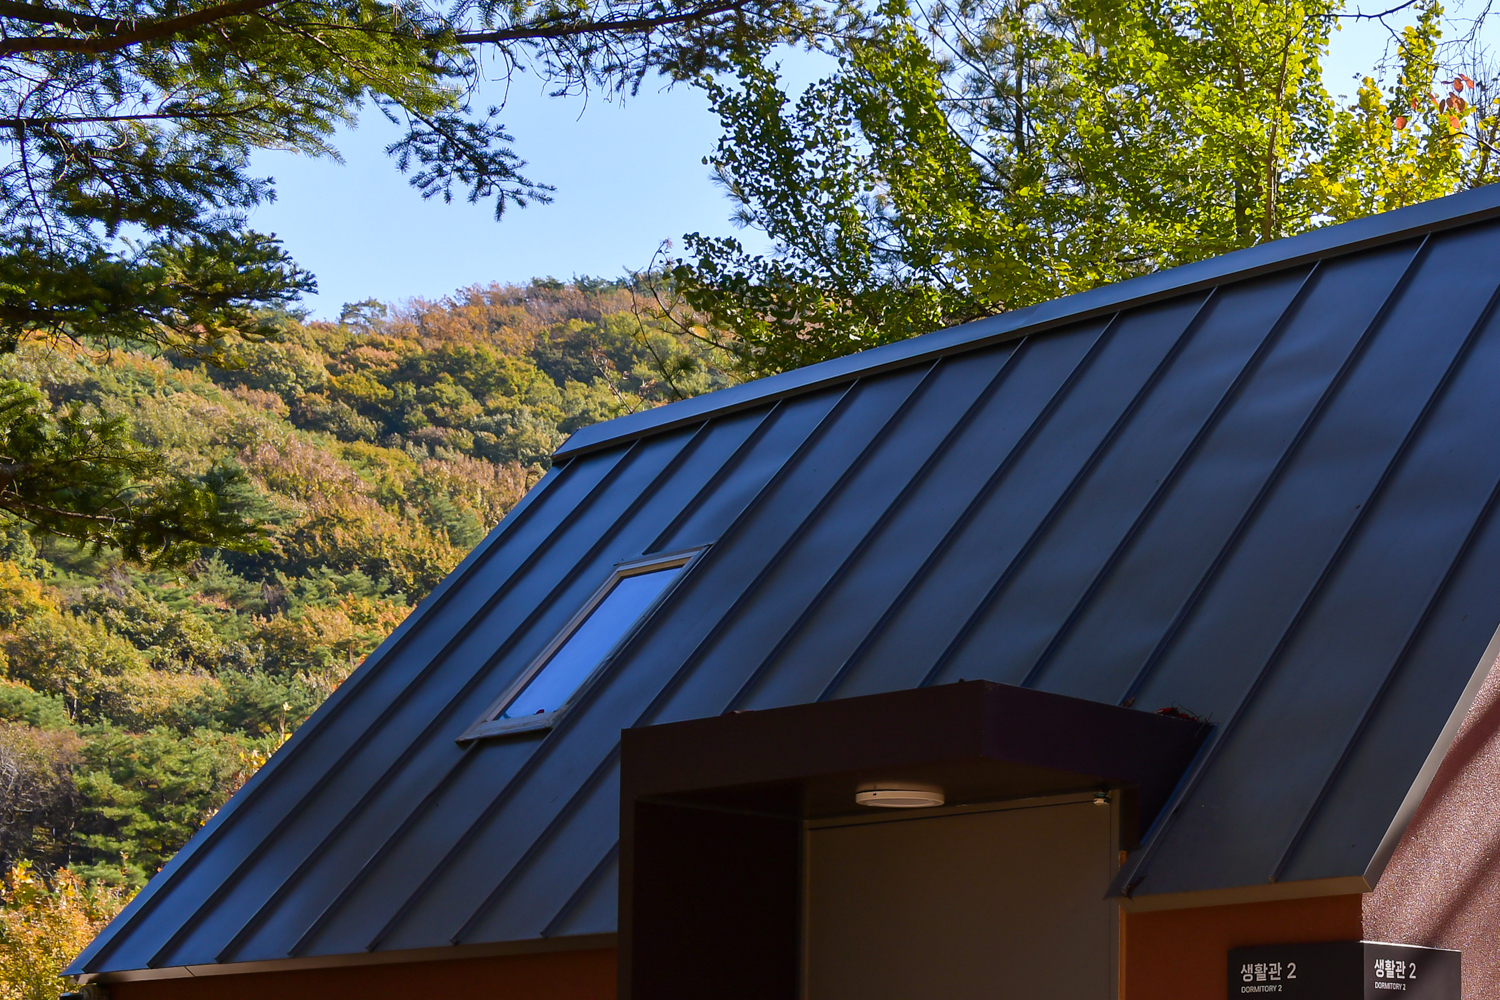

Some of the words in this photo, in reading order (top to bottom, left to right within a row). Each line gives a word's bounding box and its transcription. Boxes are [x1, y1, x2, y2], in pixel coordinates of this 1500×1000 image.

[1240, 962, 1282, 982] 생활관
[1287, 962, 1297, 979] 2
[1374, 959, 1406, 979] 생활관
[1409, 962, 1417, 979] 2
[1241, 985, 1277, 994] DORMITORY
[1278, 984, 1283, 992] 2
[1374, 981, 1402, 991] DORMITORY
[1402, 983, 1406, 991] 2
